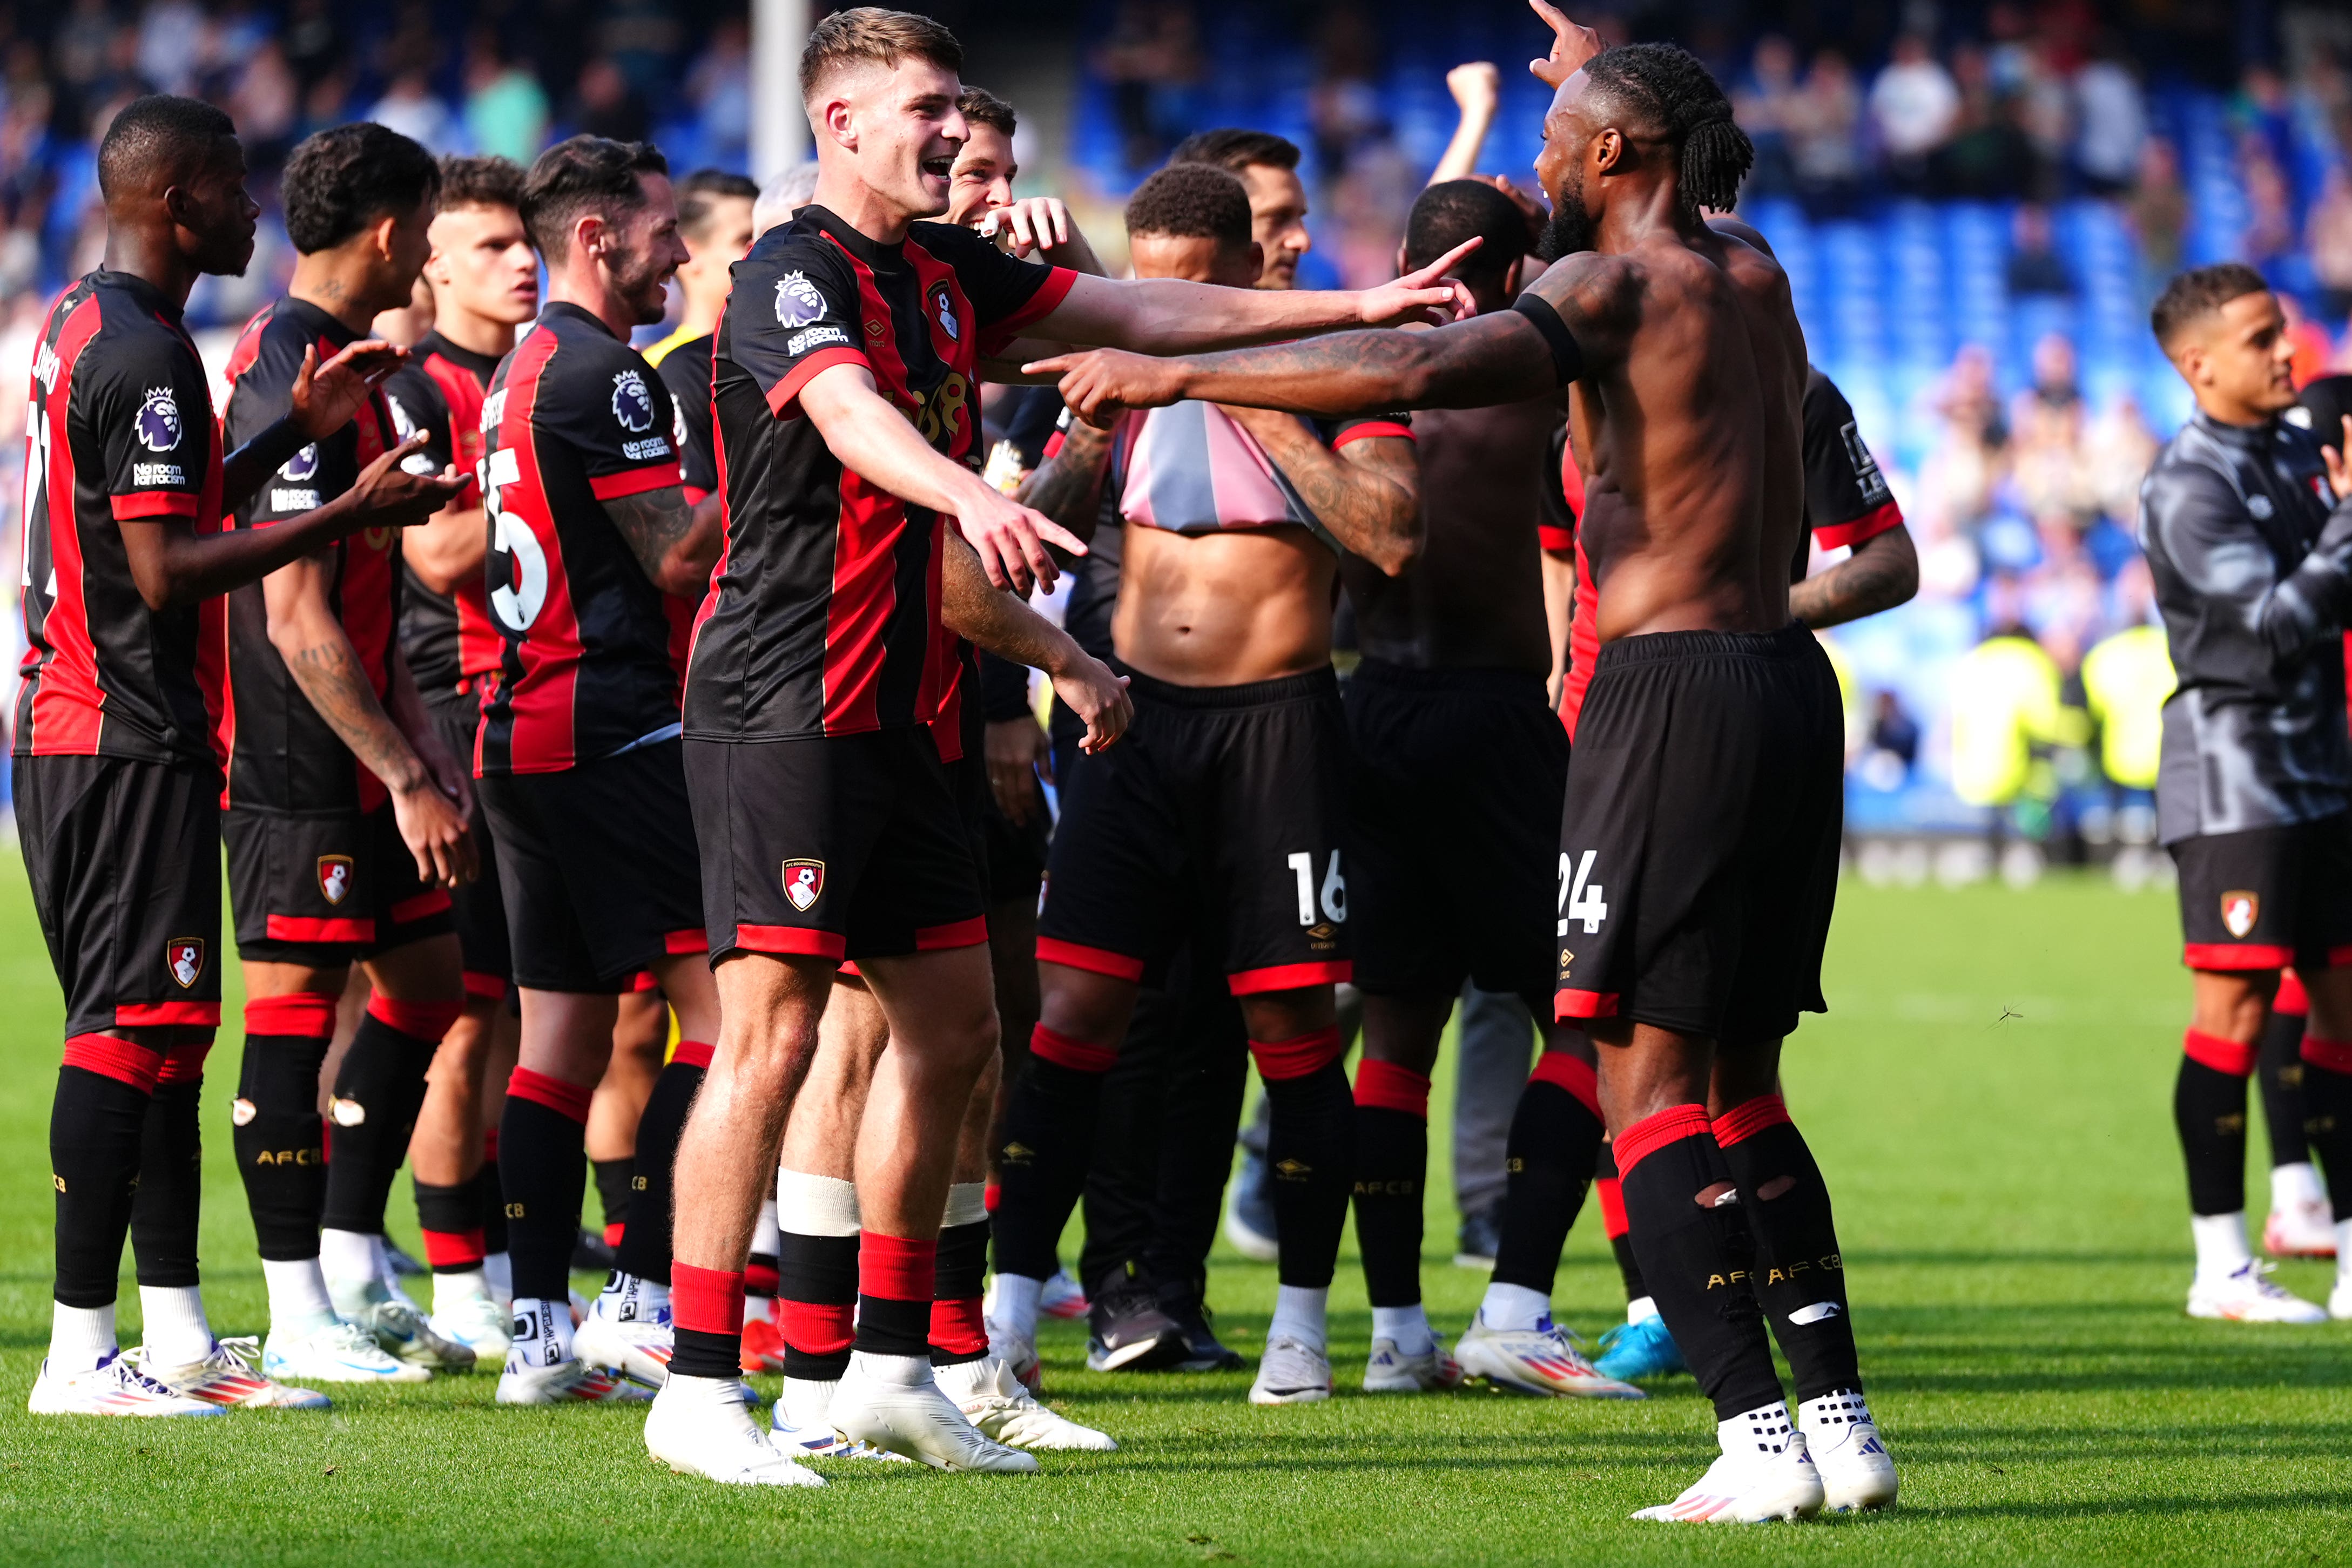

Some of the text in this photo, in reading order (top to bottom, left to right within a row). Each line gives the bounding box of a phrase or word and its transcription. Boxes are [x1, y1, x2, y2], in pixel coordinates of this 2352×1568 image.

[787, 327, 840, 347] No room
[622, 437, 665, 454] No room
[133, 463, 181, 476] No room
[1288, 848, 1346, 927] 16
[1557, 850, 1608, 937] 24
[256, 1150, 321, 1166] AFCB
[961, 1404, 982, 1414] COPA
